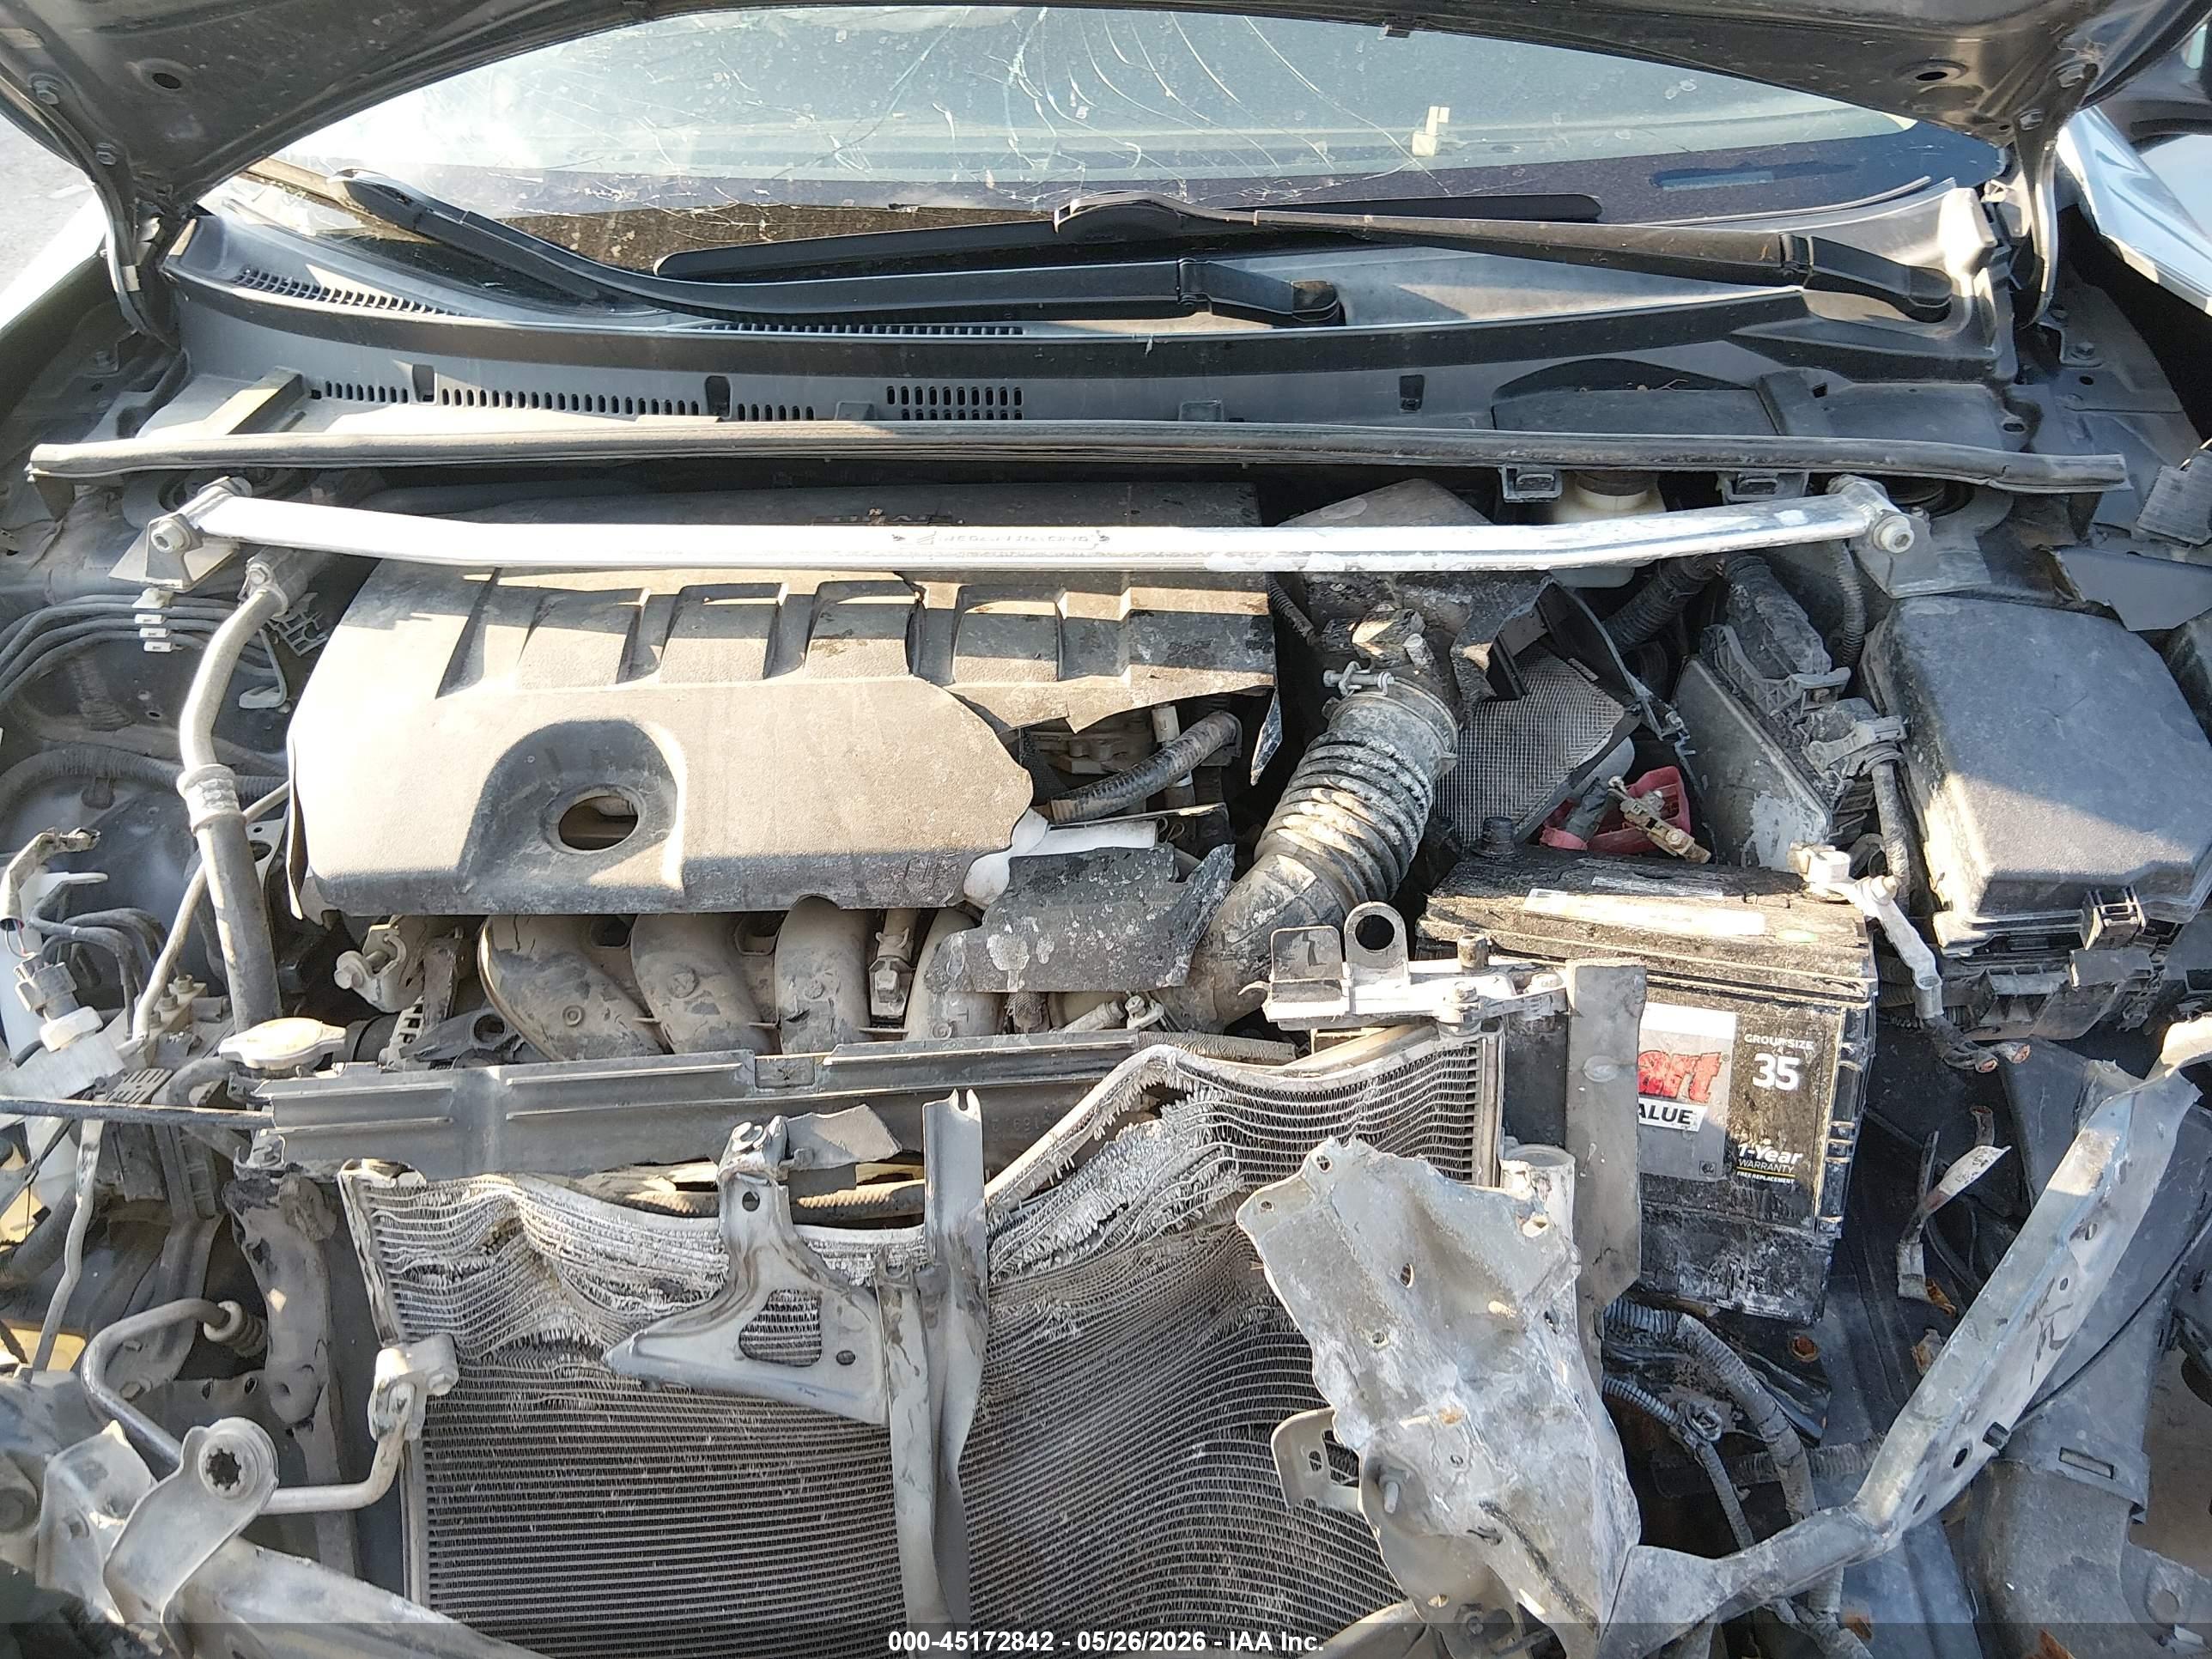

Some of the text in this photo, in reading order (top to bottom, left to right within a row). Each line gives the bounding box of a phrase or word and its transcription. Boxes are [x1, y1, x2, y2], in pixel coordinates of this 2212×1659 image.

[1787, 1039, 1814, 1051] SIZE
[1753, 1053, 1800, 1091] 35
[1638, 1103, 1693, 1125] ALUE
[1738, 1143, 1803, 1164] 1-Year
[1738, 1158, 1794, 1174] WARRANTY
[1753, 1173, 1796, 1184] REPLACEMENT
